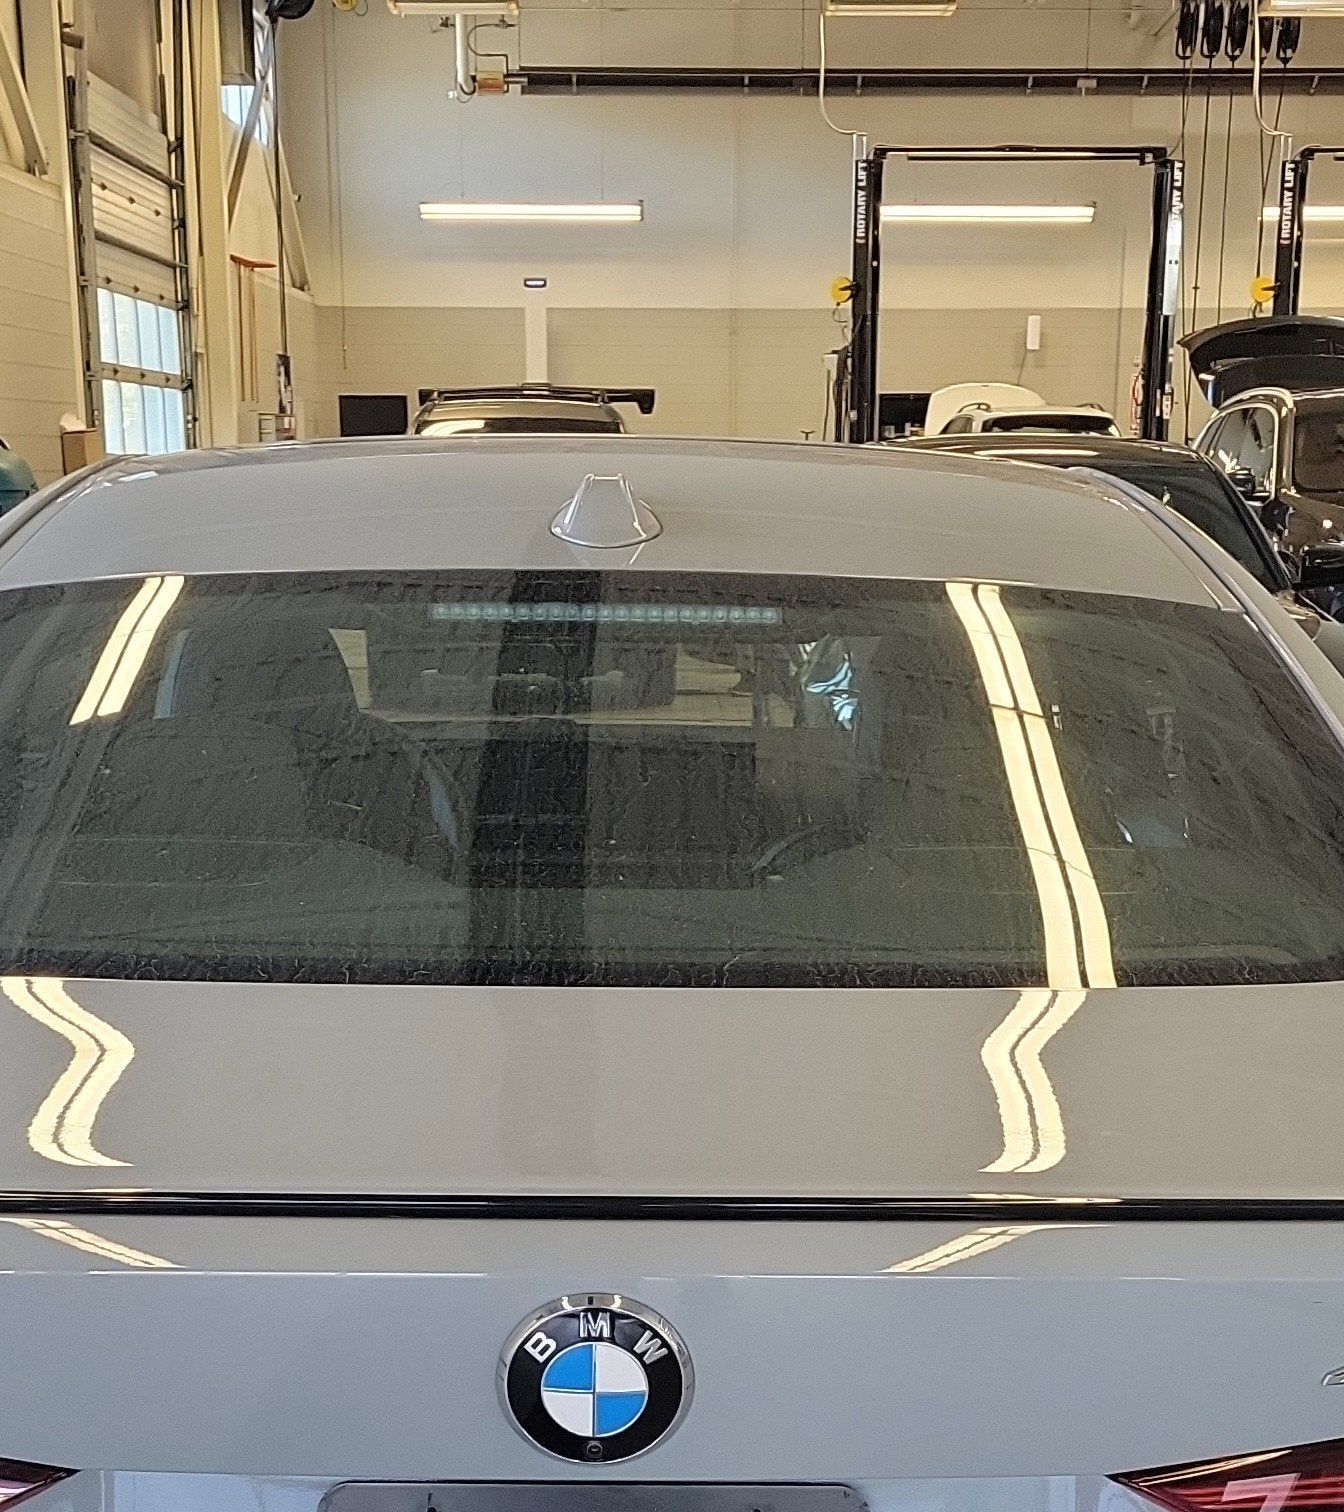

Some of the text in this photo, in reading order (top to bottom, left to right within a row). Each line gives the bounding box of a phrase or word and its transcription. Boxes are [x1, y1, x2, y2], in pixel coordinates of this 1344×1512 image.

[857, 161, 868, 187] LIFT
[1173, 161, 1183, 187] LIFT
[1280, 161, 1296, 238] ROTARY LIFT
[523, 1311, 668, 1366] BMW
